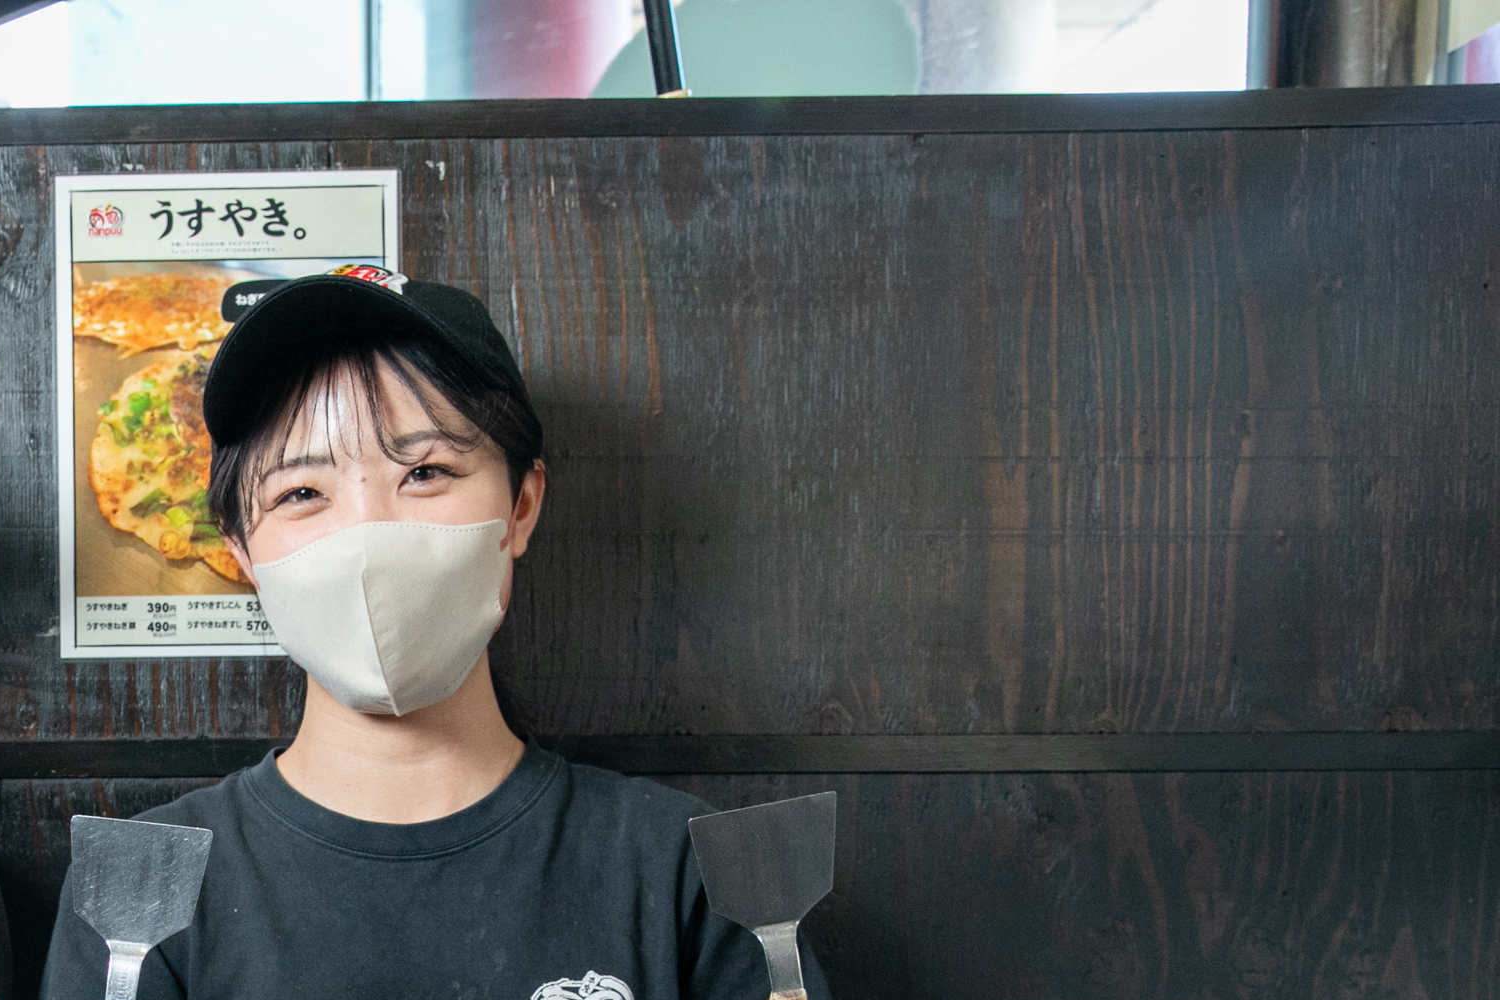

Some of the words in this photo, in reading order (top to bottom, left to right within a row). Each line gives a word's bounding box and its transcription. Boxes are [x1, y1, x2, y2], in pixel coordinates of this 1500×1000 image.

[149, 198, 307, 241] うすやき。
[88, 227, 123, 237] nanpuu
[86, 602, 128, 611] うすやきねぎ
[147, 602, 177, 613] 390円
[246, 601, 263, 612] 53
[147, 621, 177, 632] 490円
[246, 621, 271, 631] 570
